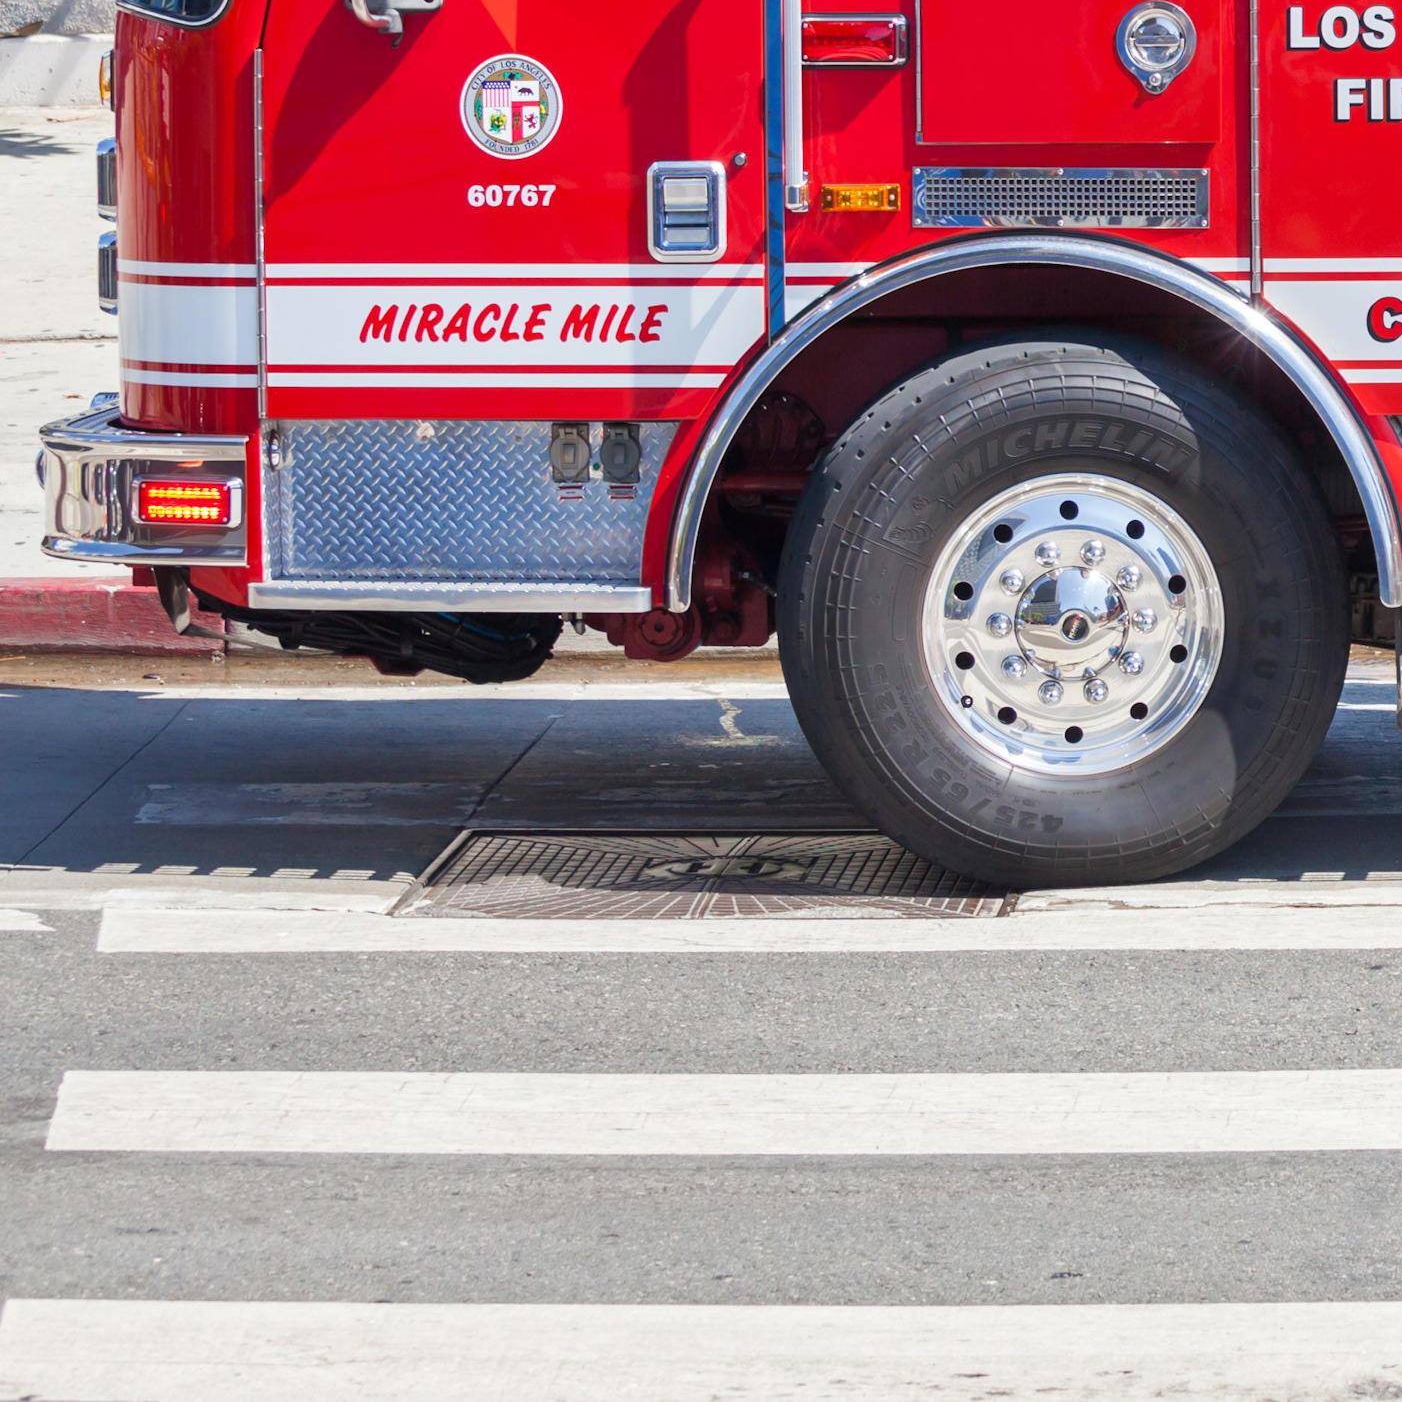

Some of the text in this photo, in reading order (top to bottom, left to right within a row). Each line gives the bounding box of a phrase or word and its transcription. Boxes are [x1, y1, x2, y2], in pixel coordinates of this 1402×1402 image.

[1287, 4, 1397, 51] LOS
[470, 60, 552, 91] CITY OF LOS ANGELES
[484, 136, 540, 154] FOUNDED 1781
[467, 184, 557, 209] 60767
[359, 303, 669, 344] MIRACLE MILE
[944, 418, 1199, 493] MICHELIN
